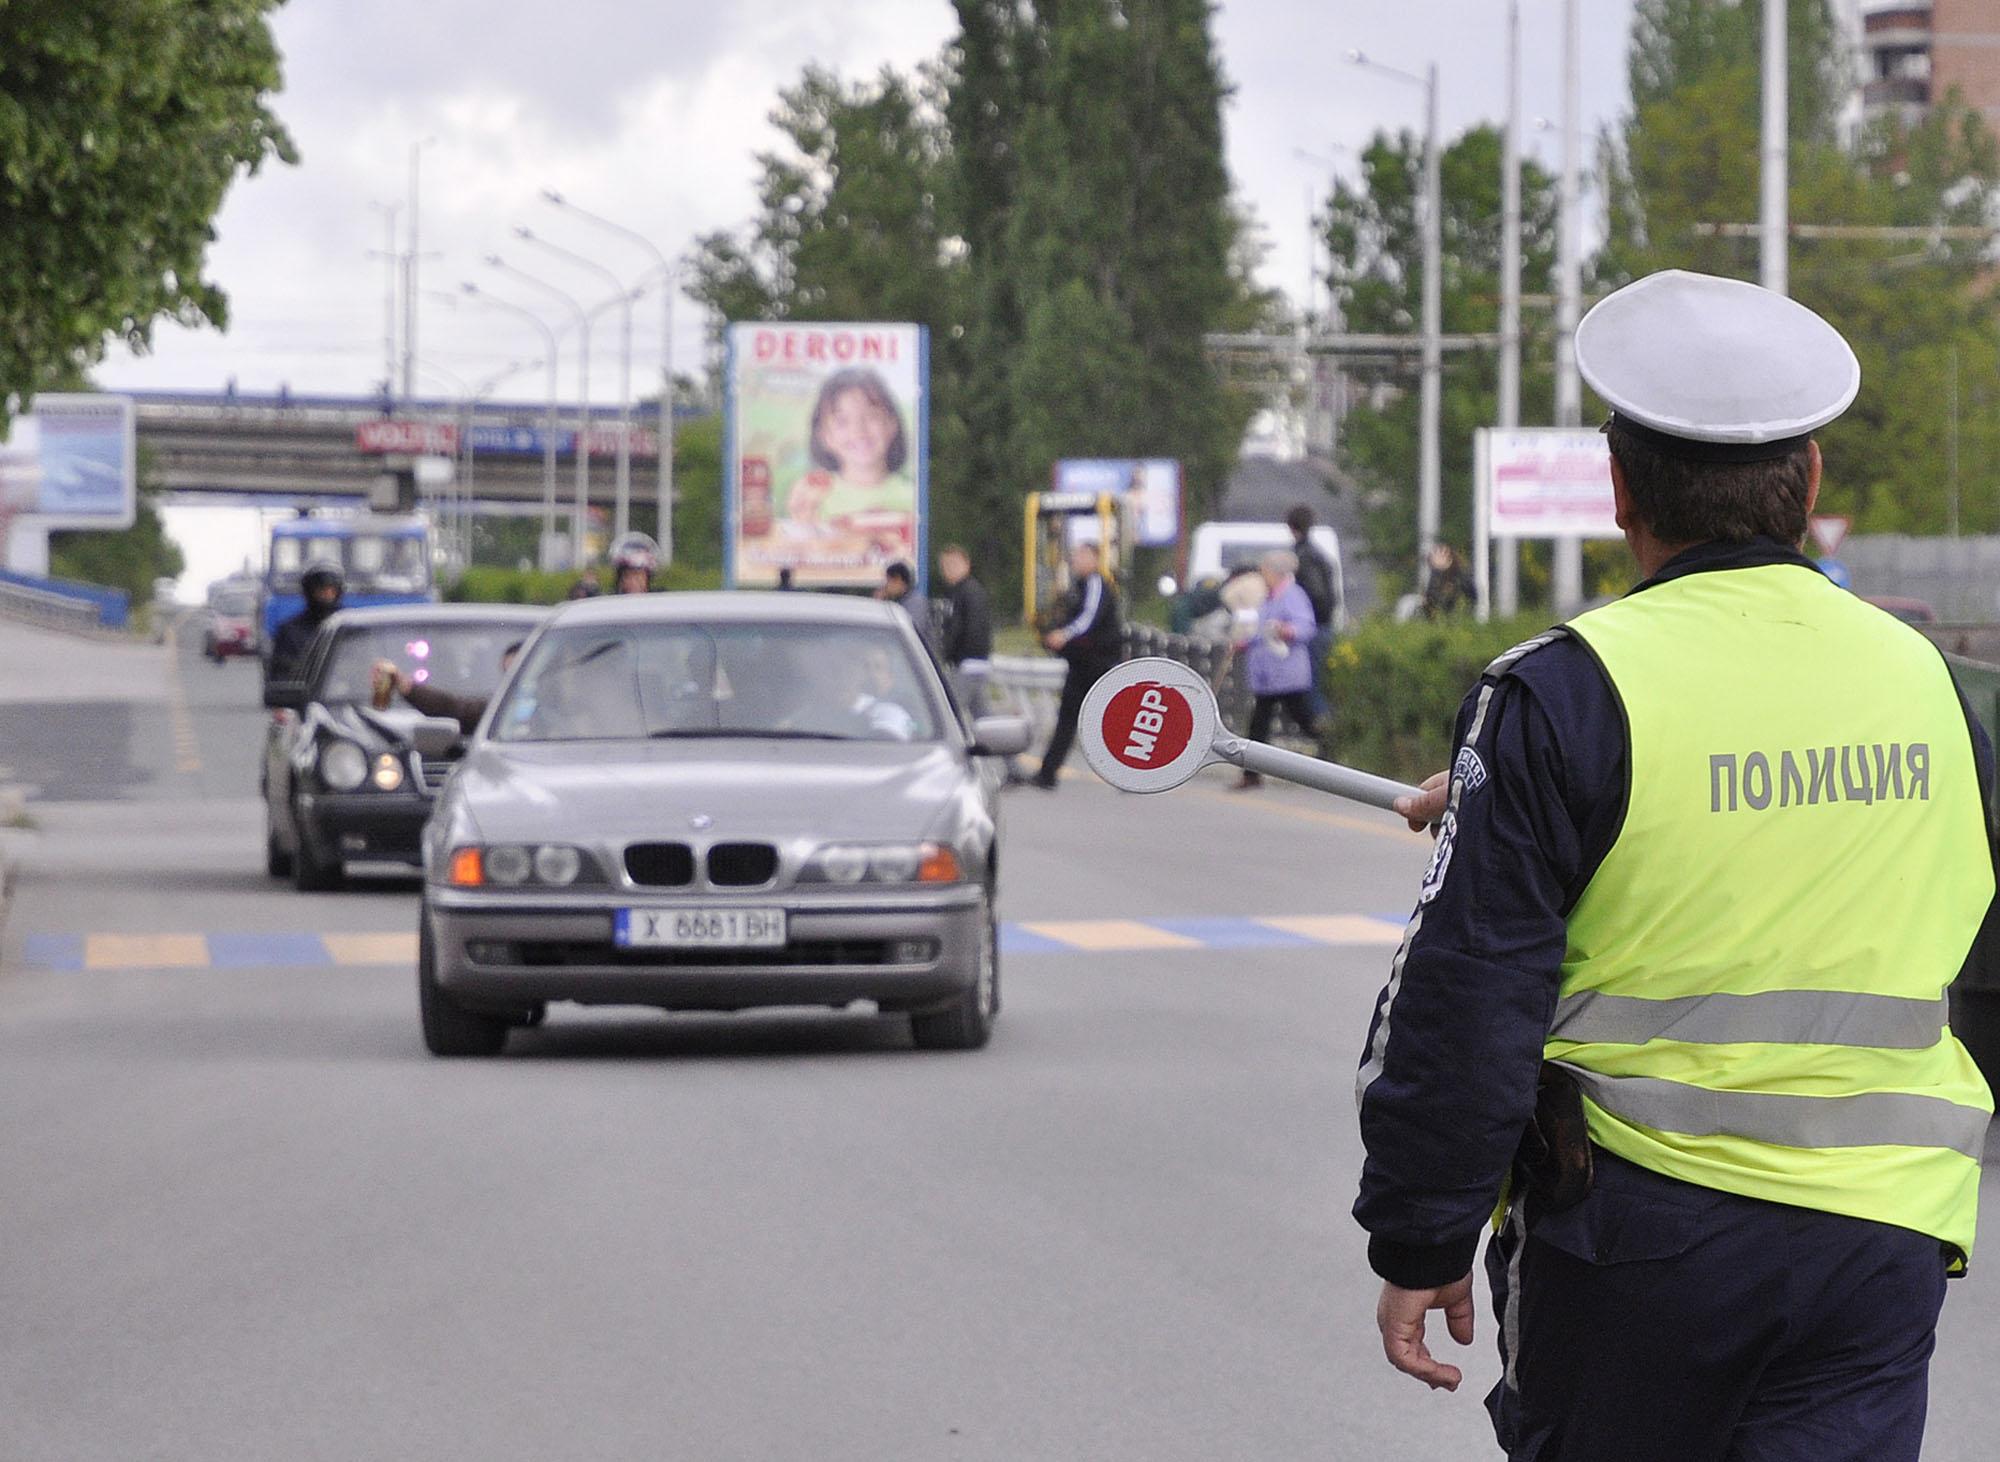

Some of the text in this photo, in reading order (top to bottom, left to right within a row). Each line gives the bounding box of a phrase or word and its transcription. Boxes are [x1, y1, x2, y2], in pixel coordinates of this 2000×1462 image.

[754, 329, 899, 363] DERONI
[1123, 689, 1169, 762] МВР
[1709, 743, 1930, 812] ПОЛИЦИЯ
